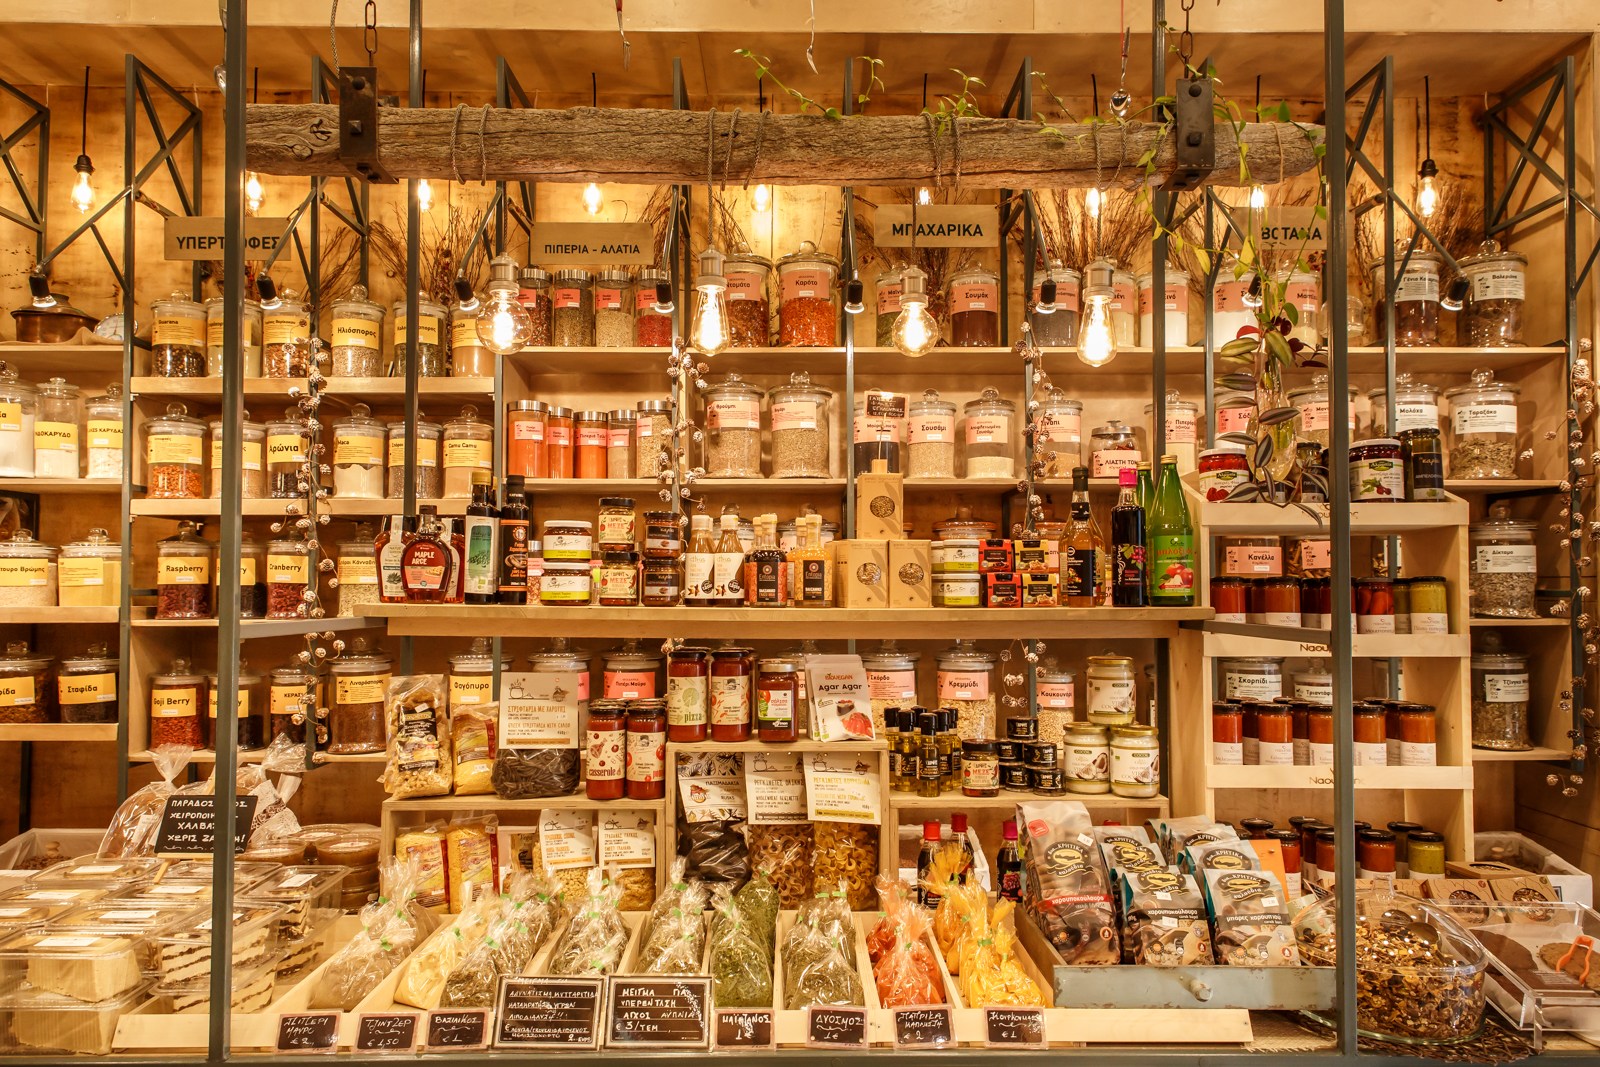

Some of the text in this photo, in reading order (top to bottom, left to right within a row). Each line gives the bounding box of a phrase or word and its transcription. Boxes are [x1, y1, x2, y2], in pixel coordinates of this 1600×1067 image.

[892, 223, 984, 237] ΜΠΑΧΑΡΙΚΑ
[176, 236, 281, 250] ΥΠΕΡΤΦΕΣ
[544, 244, 589, 254] ΠΙΠΕΡΙΑ
[600, 244, 640, 254] ΑΛΑΤΙΑ
[337, 326, 377, 338] Ηλιόσπορος
[166, 565, 204, 574] Raspberry
[269, 563, 302, 572] Cranberry
[1238, 676, 1268, 684] Σκορπίδι
[67, 684, 98, 694] Σταφίδα
[818, 684, 839, 692] Agar
[166, 698, 190, 706] Berry
[684, 712, 702, 724] pizza
[589, 767, 616, 776] casserole
[171, 800, 248, 808] ΠΑΡΑΔΟΣΟΣ
[622, 988, 655, 996] ΜΕΙΓΜΑ
[816, 1014, 864, 1028] ΔΥΟΣΜΟΣ
[916, 1030, 924, 1040] 2
